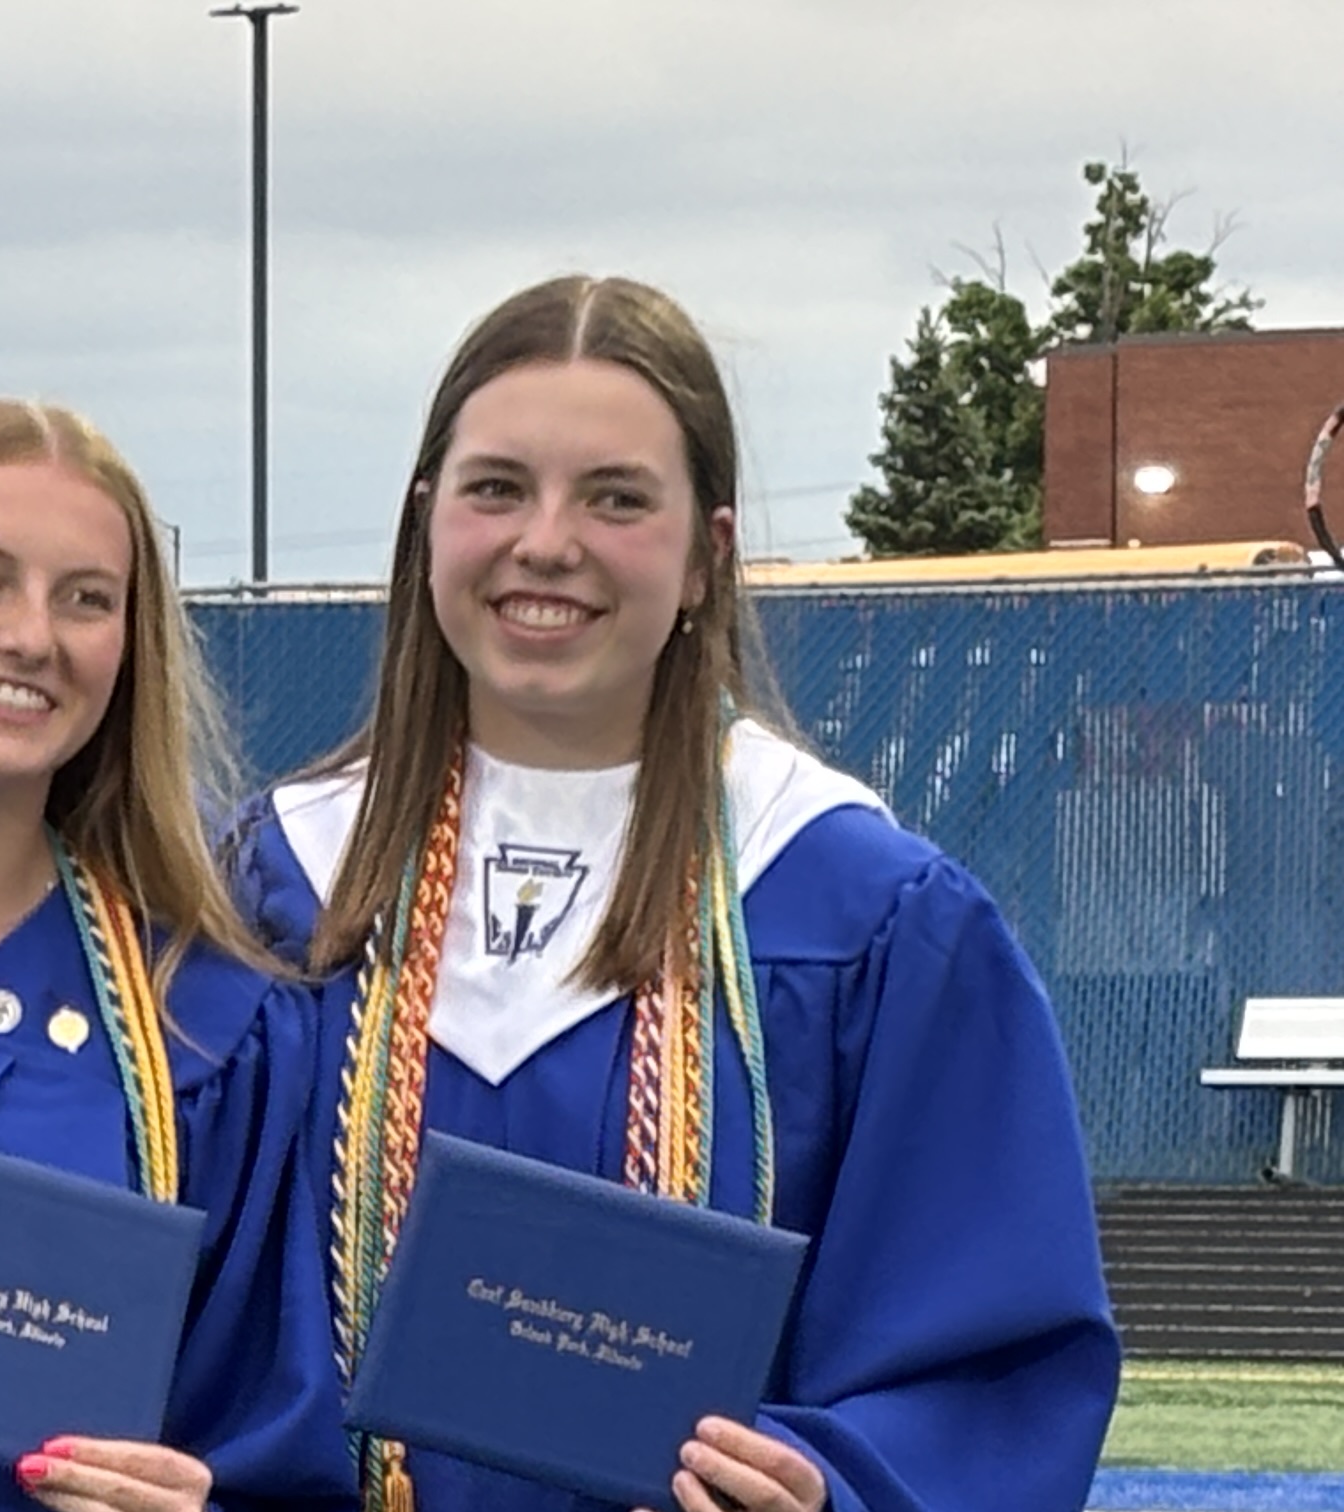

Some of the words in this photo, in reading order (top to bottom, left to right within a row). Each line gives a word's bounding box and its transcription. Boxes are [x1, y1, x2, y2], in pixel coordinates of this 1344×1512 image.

[13, 1289, 50, 1322] High
[52, 1303, 109, 1332] School
[467, 1278, 504, 1305] Carl
[588, 1312, 627, 1345] High
[631, 1326, 694, 1358] School
